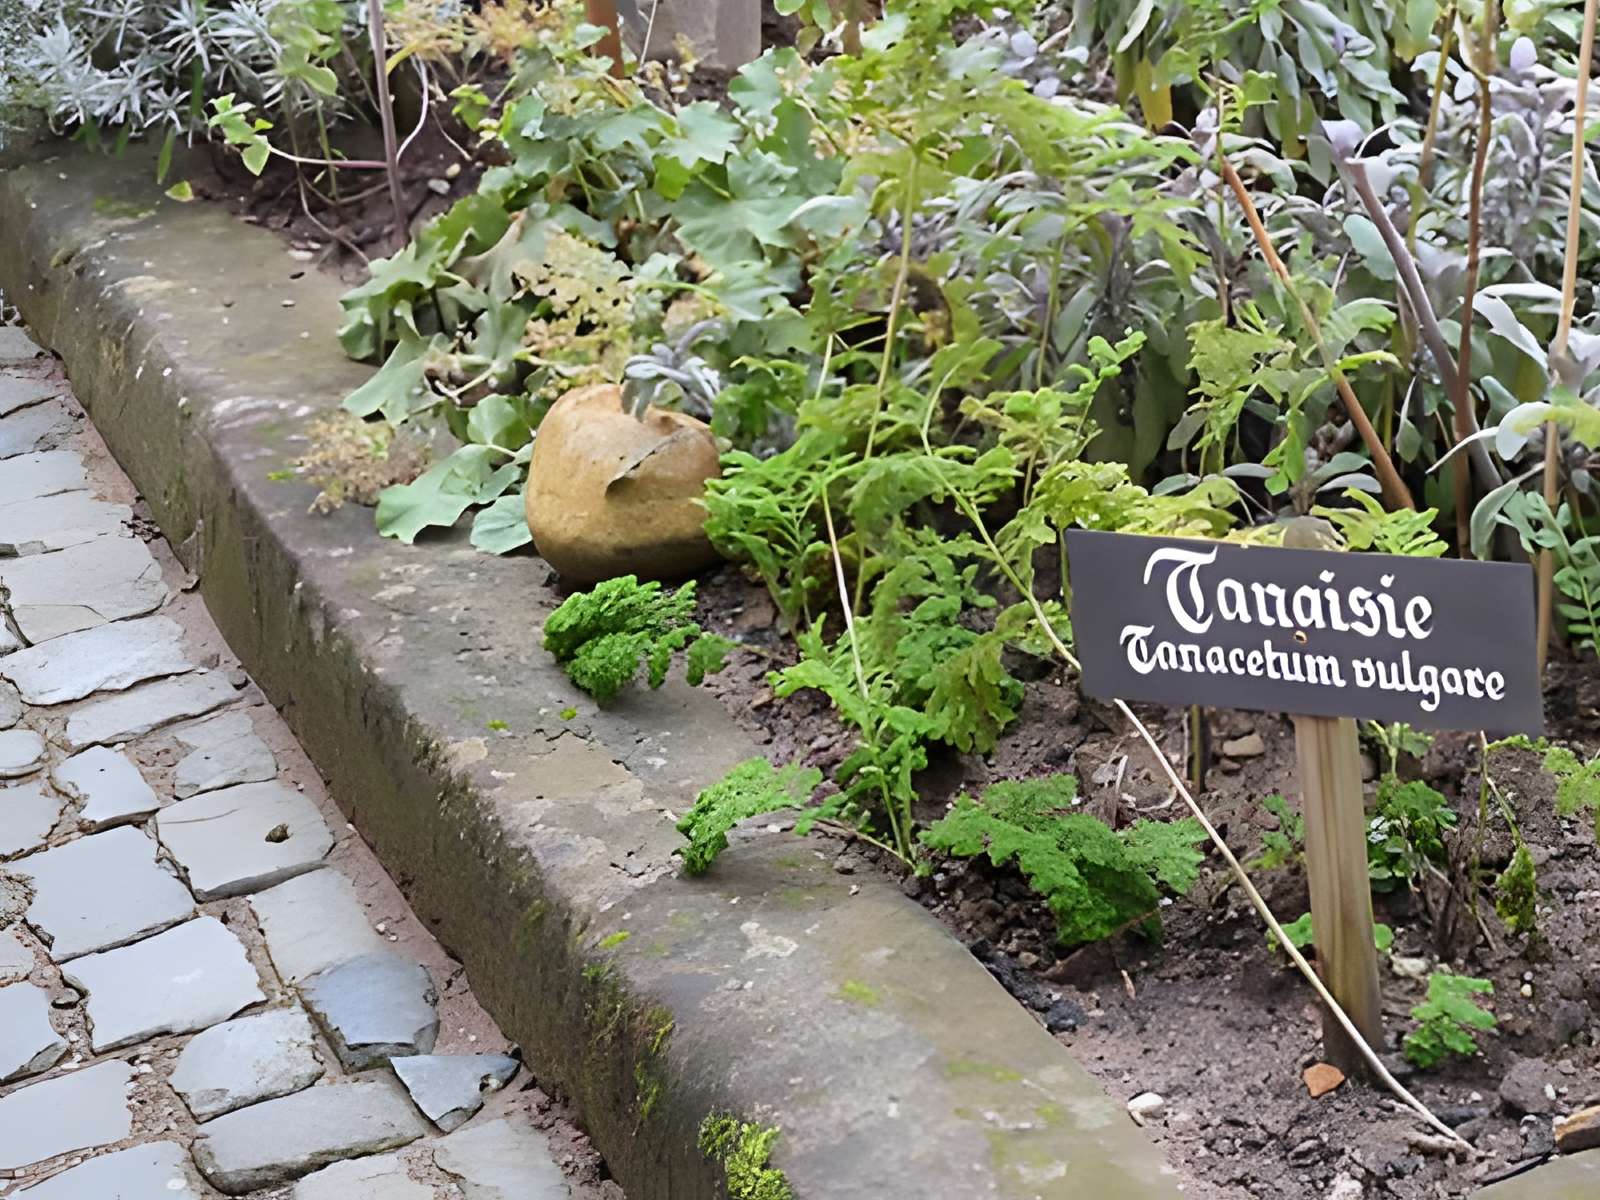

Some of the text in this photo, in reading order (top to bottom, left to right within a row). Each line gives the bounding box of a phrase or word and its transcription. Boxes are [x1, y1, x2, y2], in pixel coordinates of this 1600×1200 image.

[1143, 545, 1433, 640] Tanaisie
[1120, 623, 1505, 712] Tanacetum vulgare
